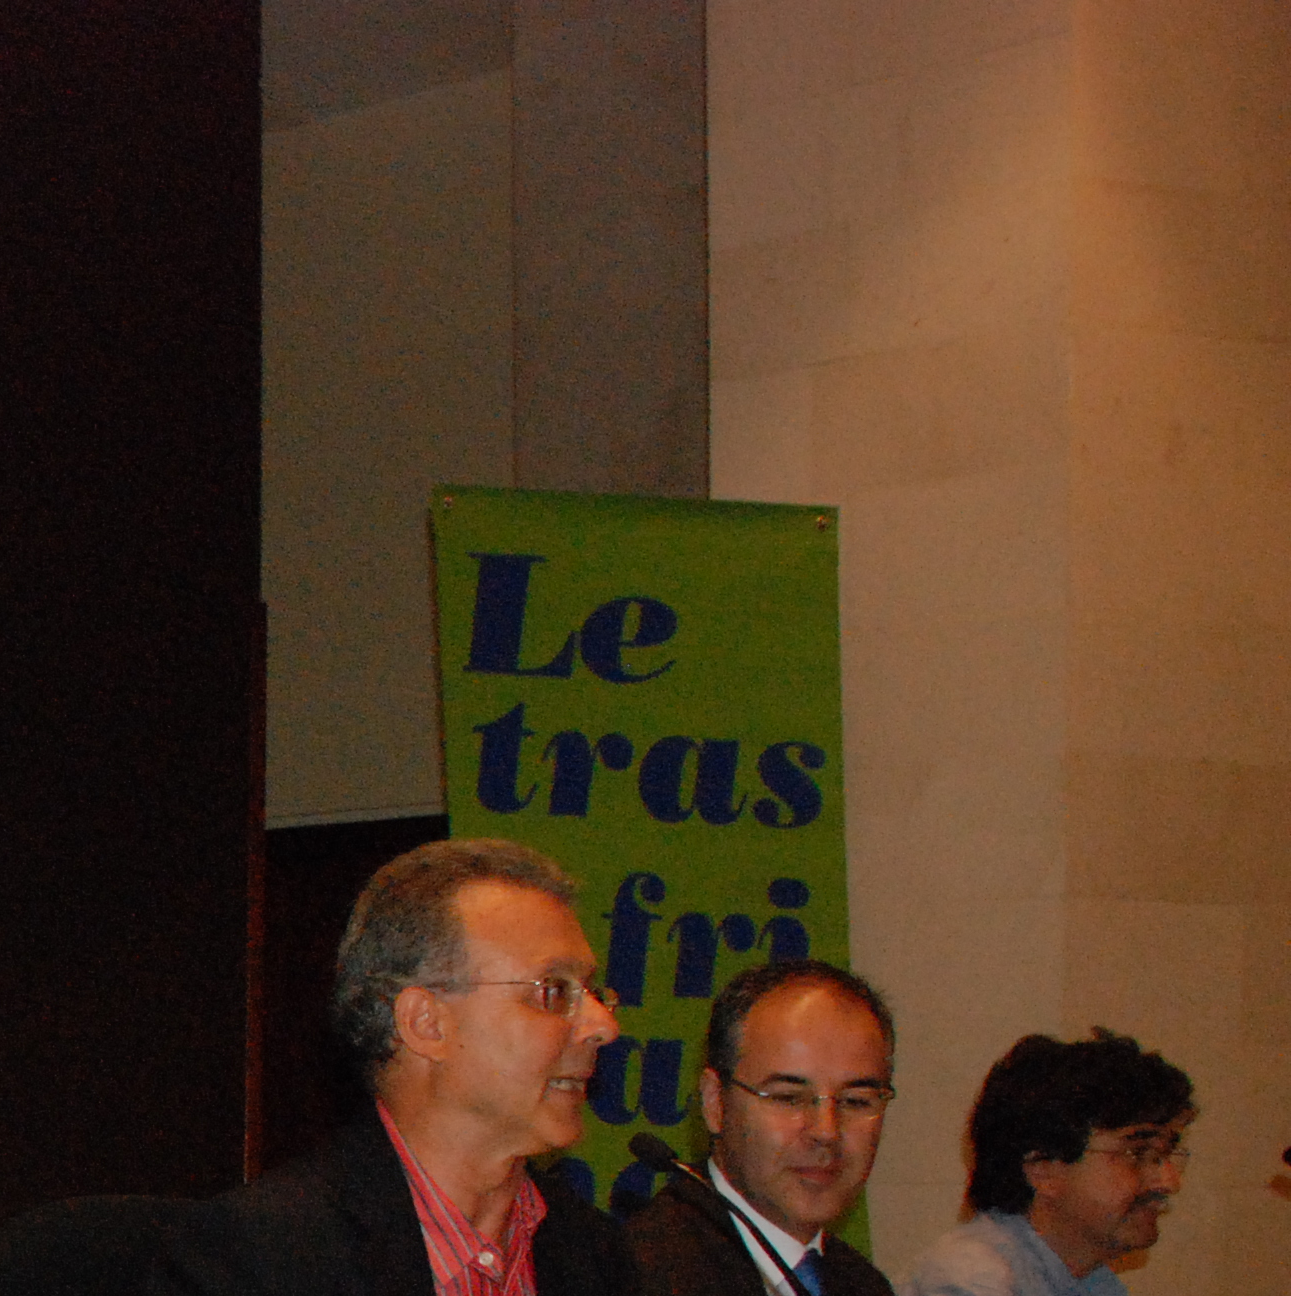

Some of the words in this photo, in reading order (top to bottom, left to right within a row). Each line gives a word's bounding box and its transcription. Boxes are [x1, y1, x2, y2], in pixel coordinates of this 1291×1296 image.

[463, 551, 678, 684] Le
[472, 701, 827, 828] tras
[600, 872, 812, 1008] fri
